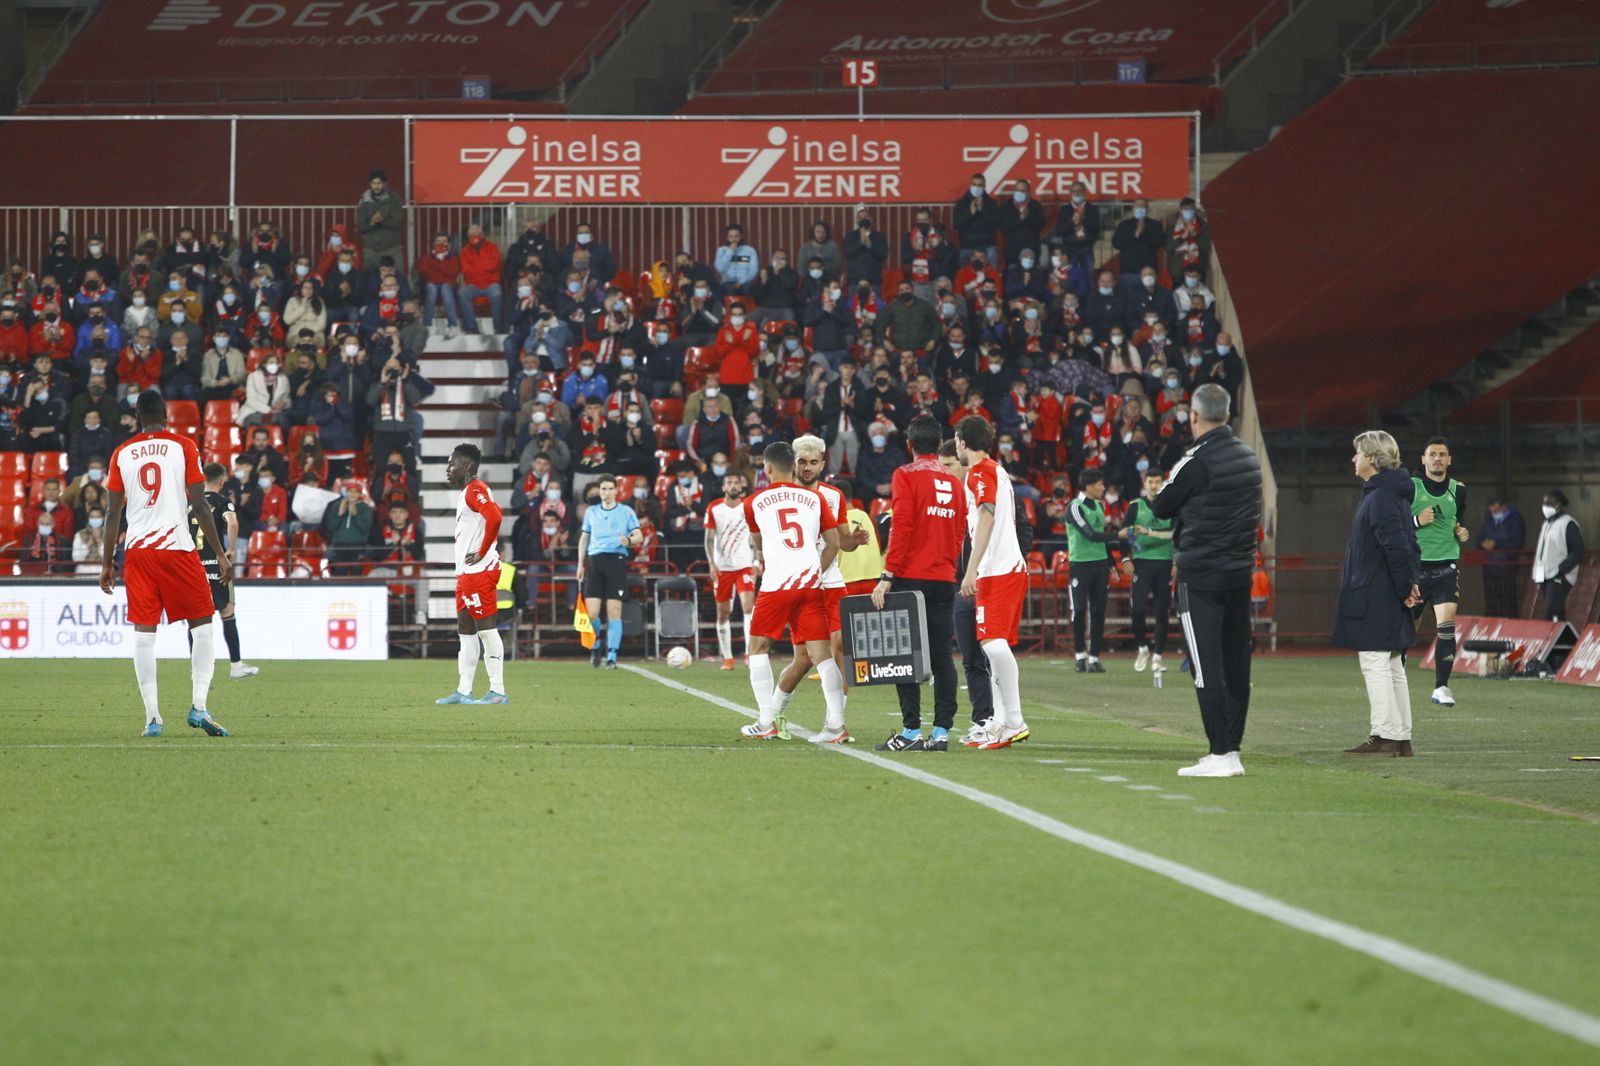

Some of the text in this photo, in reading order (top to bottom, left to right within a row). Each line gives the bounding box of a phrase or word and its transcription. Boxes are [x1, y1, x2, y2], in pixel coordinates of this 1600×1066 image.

[233, 1, 564, 28] DEKTON
[216, 33, 479, 47] designed by COSENTINO
[830, 26, 1175, 51] Automotor Costa
[847, 61, 876, 84] 15
[1119, 67, 1139, 80] 117
[463, 86, 485, 98] 118
[533, 134, 641, 163] inelsa
[793, 134, 901, 163] inelsa
[1034, 131, 1143, 160] inelsa
[533, 173, 641, 198] ZENER
[793, 173, 902, 197] ZENER
[1035, 171, 1143, 195] ZENER
[131, 444, 168, 460] SADIQ
[139, 462, 162, 509] 9
[757, 492, 818, 511] ROBERTONE
[927, 505, 956, 519] WRT
[777, 507, 805, 550] 5
[56, 631, 123, 646] CIUDAD
[870, 662, 913, 678] LiveScore
